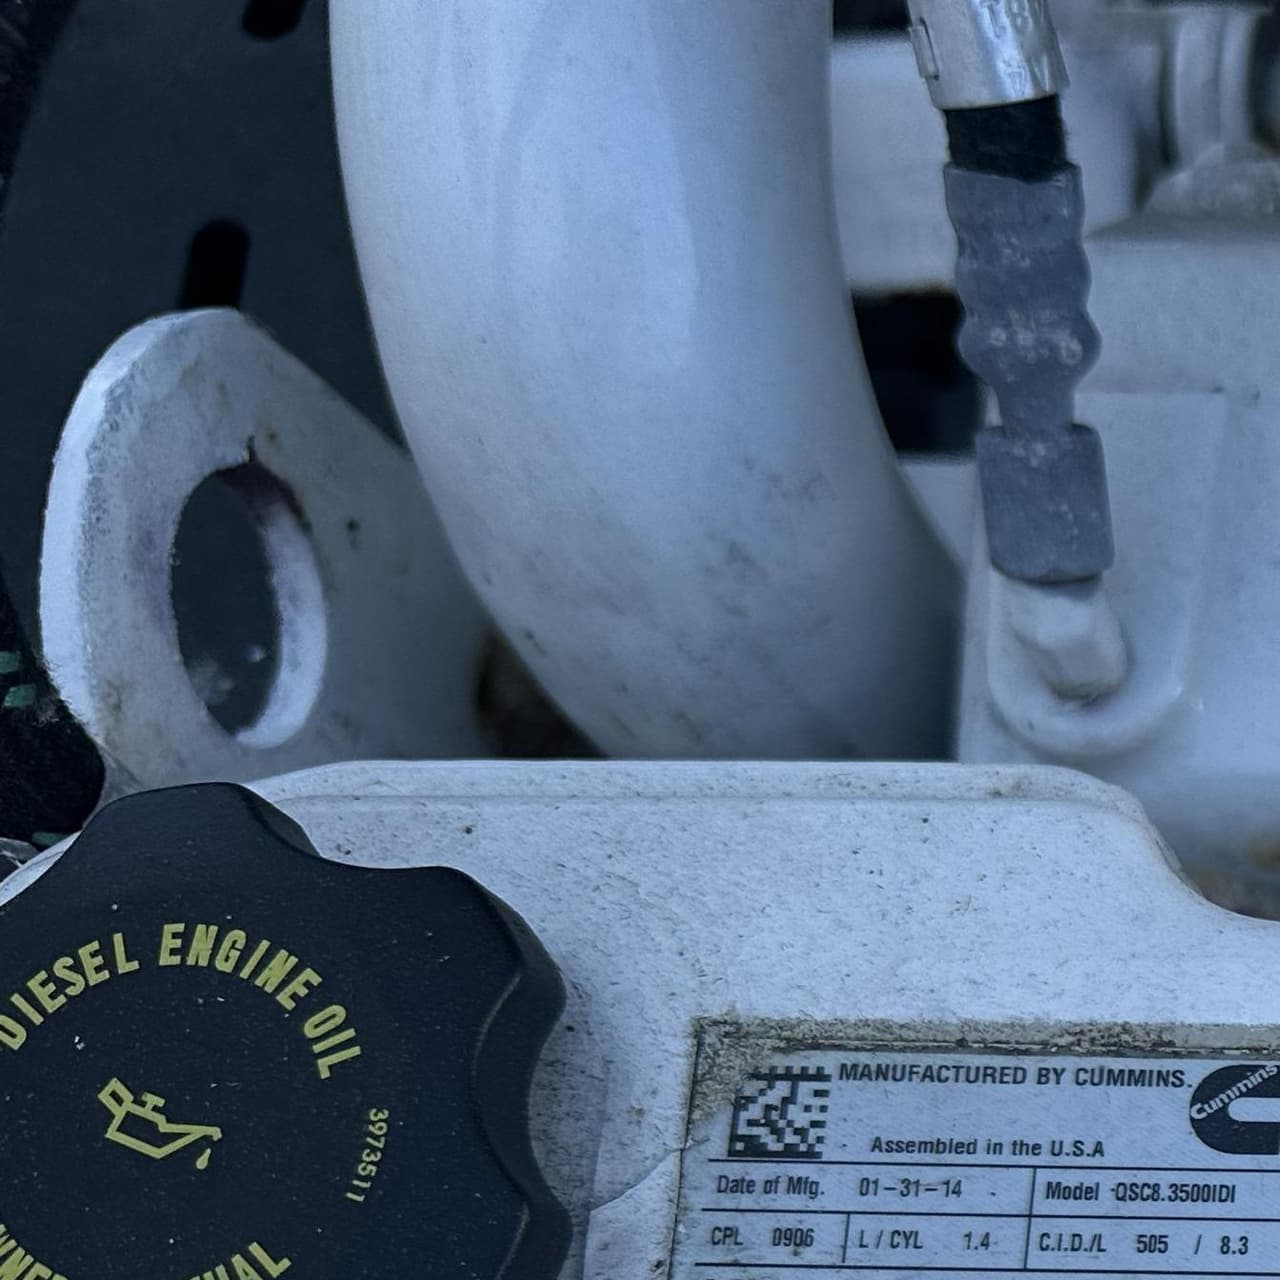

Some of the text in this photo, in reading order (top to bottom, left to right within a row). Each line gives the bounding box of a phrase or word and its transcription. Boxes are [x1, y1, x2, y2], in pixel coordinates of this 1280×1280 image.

[158, 922, 323, 1011] ENGINE
[303, 1003, 362, 1080] OIL
[838, 1063, 1066, 1085] MANUFACTURED BY
[1189, 1064, 1279, 1120] Cummins
[346, 1109, 389, 1202] 3973511
[870, 1136, 1104, 1158] Assembled in the U.S.A
[717, 1175, 825, 1200] Date of Mfg.
[1045, 1181, 1100, 1201] Model
[711, 1226, 814, 1248] CPL 0906
[964, 1232, 990, 1250] 1.4
[1039, 1232, 1107, 1252] C.I.D./L
[1136, 1234, 1169, 1254] 505
[1220, 1235, 1249, 1255] 8.3
